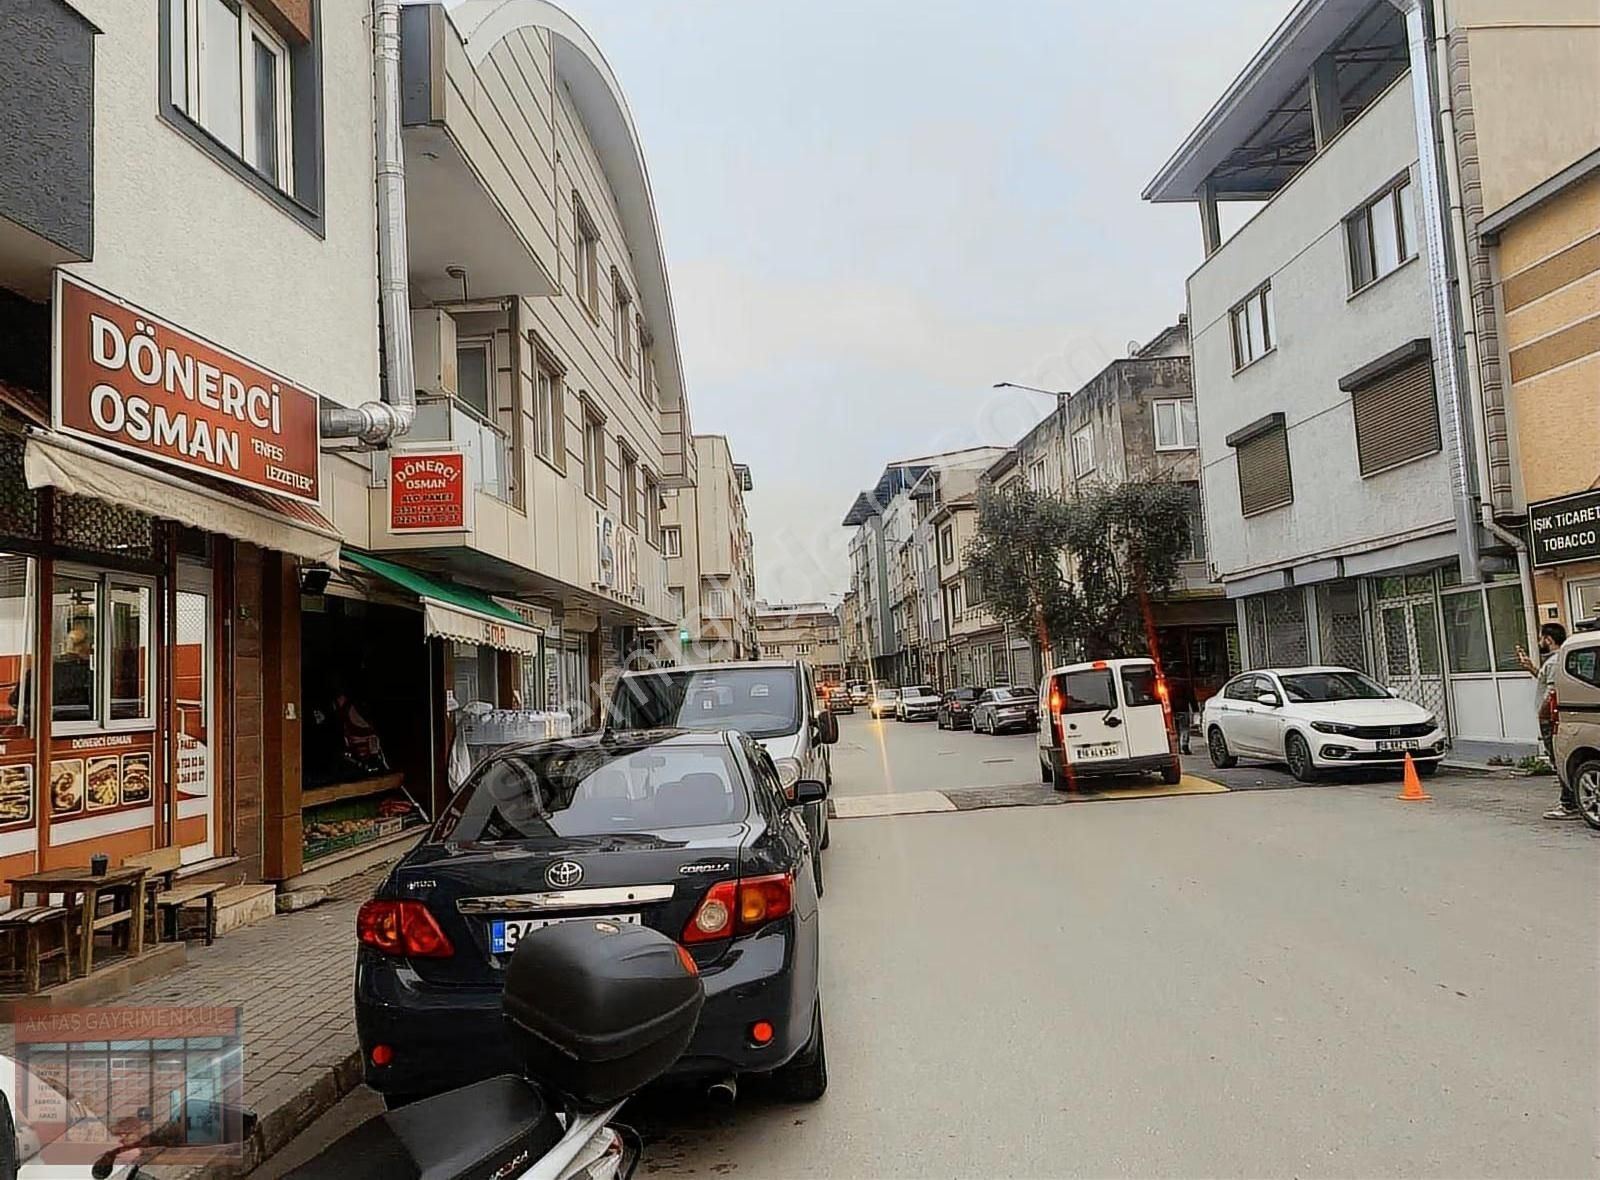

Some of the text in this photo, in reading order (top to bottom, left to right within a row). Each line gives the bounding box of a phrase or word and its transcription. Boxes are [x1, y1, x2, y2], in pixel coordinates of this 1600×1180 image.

[90, 314, 281, 435] DÖNERCİ
[90, 384, 240, 471] OSMAN
[394, 461, 461, 482] DÖNERCİ
[406, 479, 447, 490] OSMAN
[1543, 530, 1596, 552] TOBACCO
[680, 863, 730, 874] COROLLA
